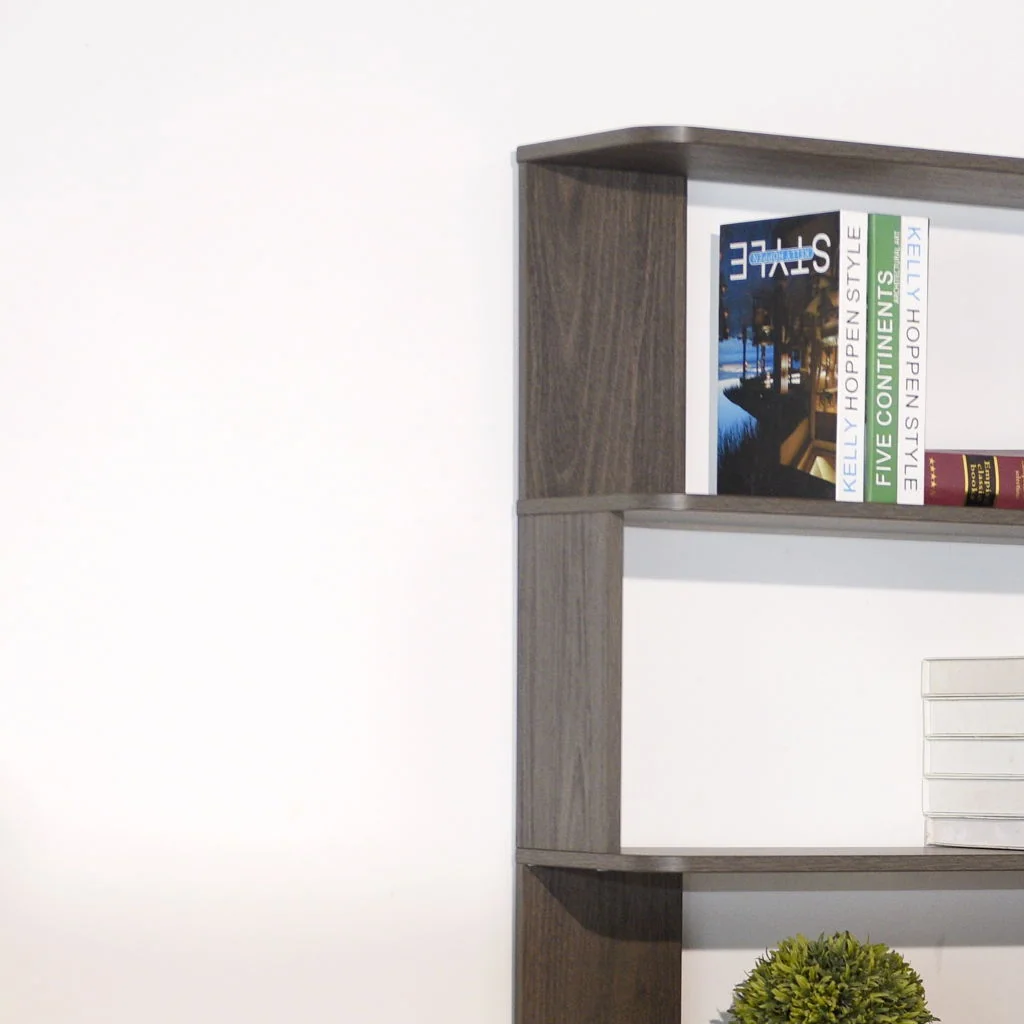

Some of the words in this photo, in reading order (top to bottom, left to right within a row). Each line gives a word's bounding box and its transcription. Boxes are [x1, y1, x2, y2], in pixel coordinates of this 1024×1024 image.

[729, 232, 831, 281] STYLE
[846, 226, 861, 303] STYLE
[906, 226, 921, 302] KELLY
[844, 309, 860, 412] HOPPEN
[875, 269, 894, 426] CONTINENTS
[905, 309, 920, 409] HOPPEN
[842, 418, 858, 493] KELLY
[875, 433, 892, 487] FIVE
[904, 416, 919, 492] STYLE
